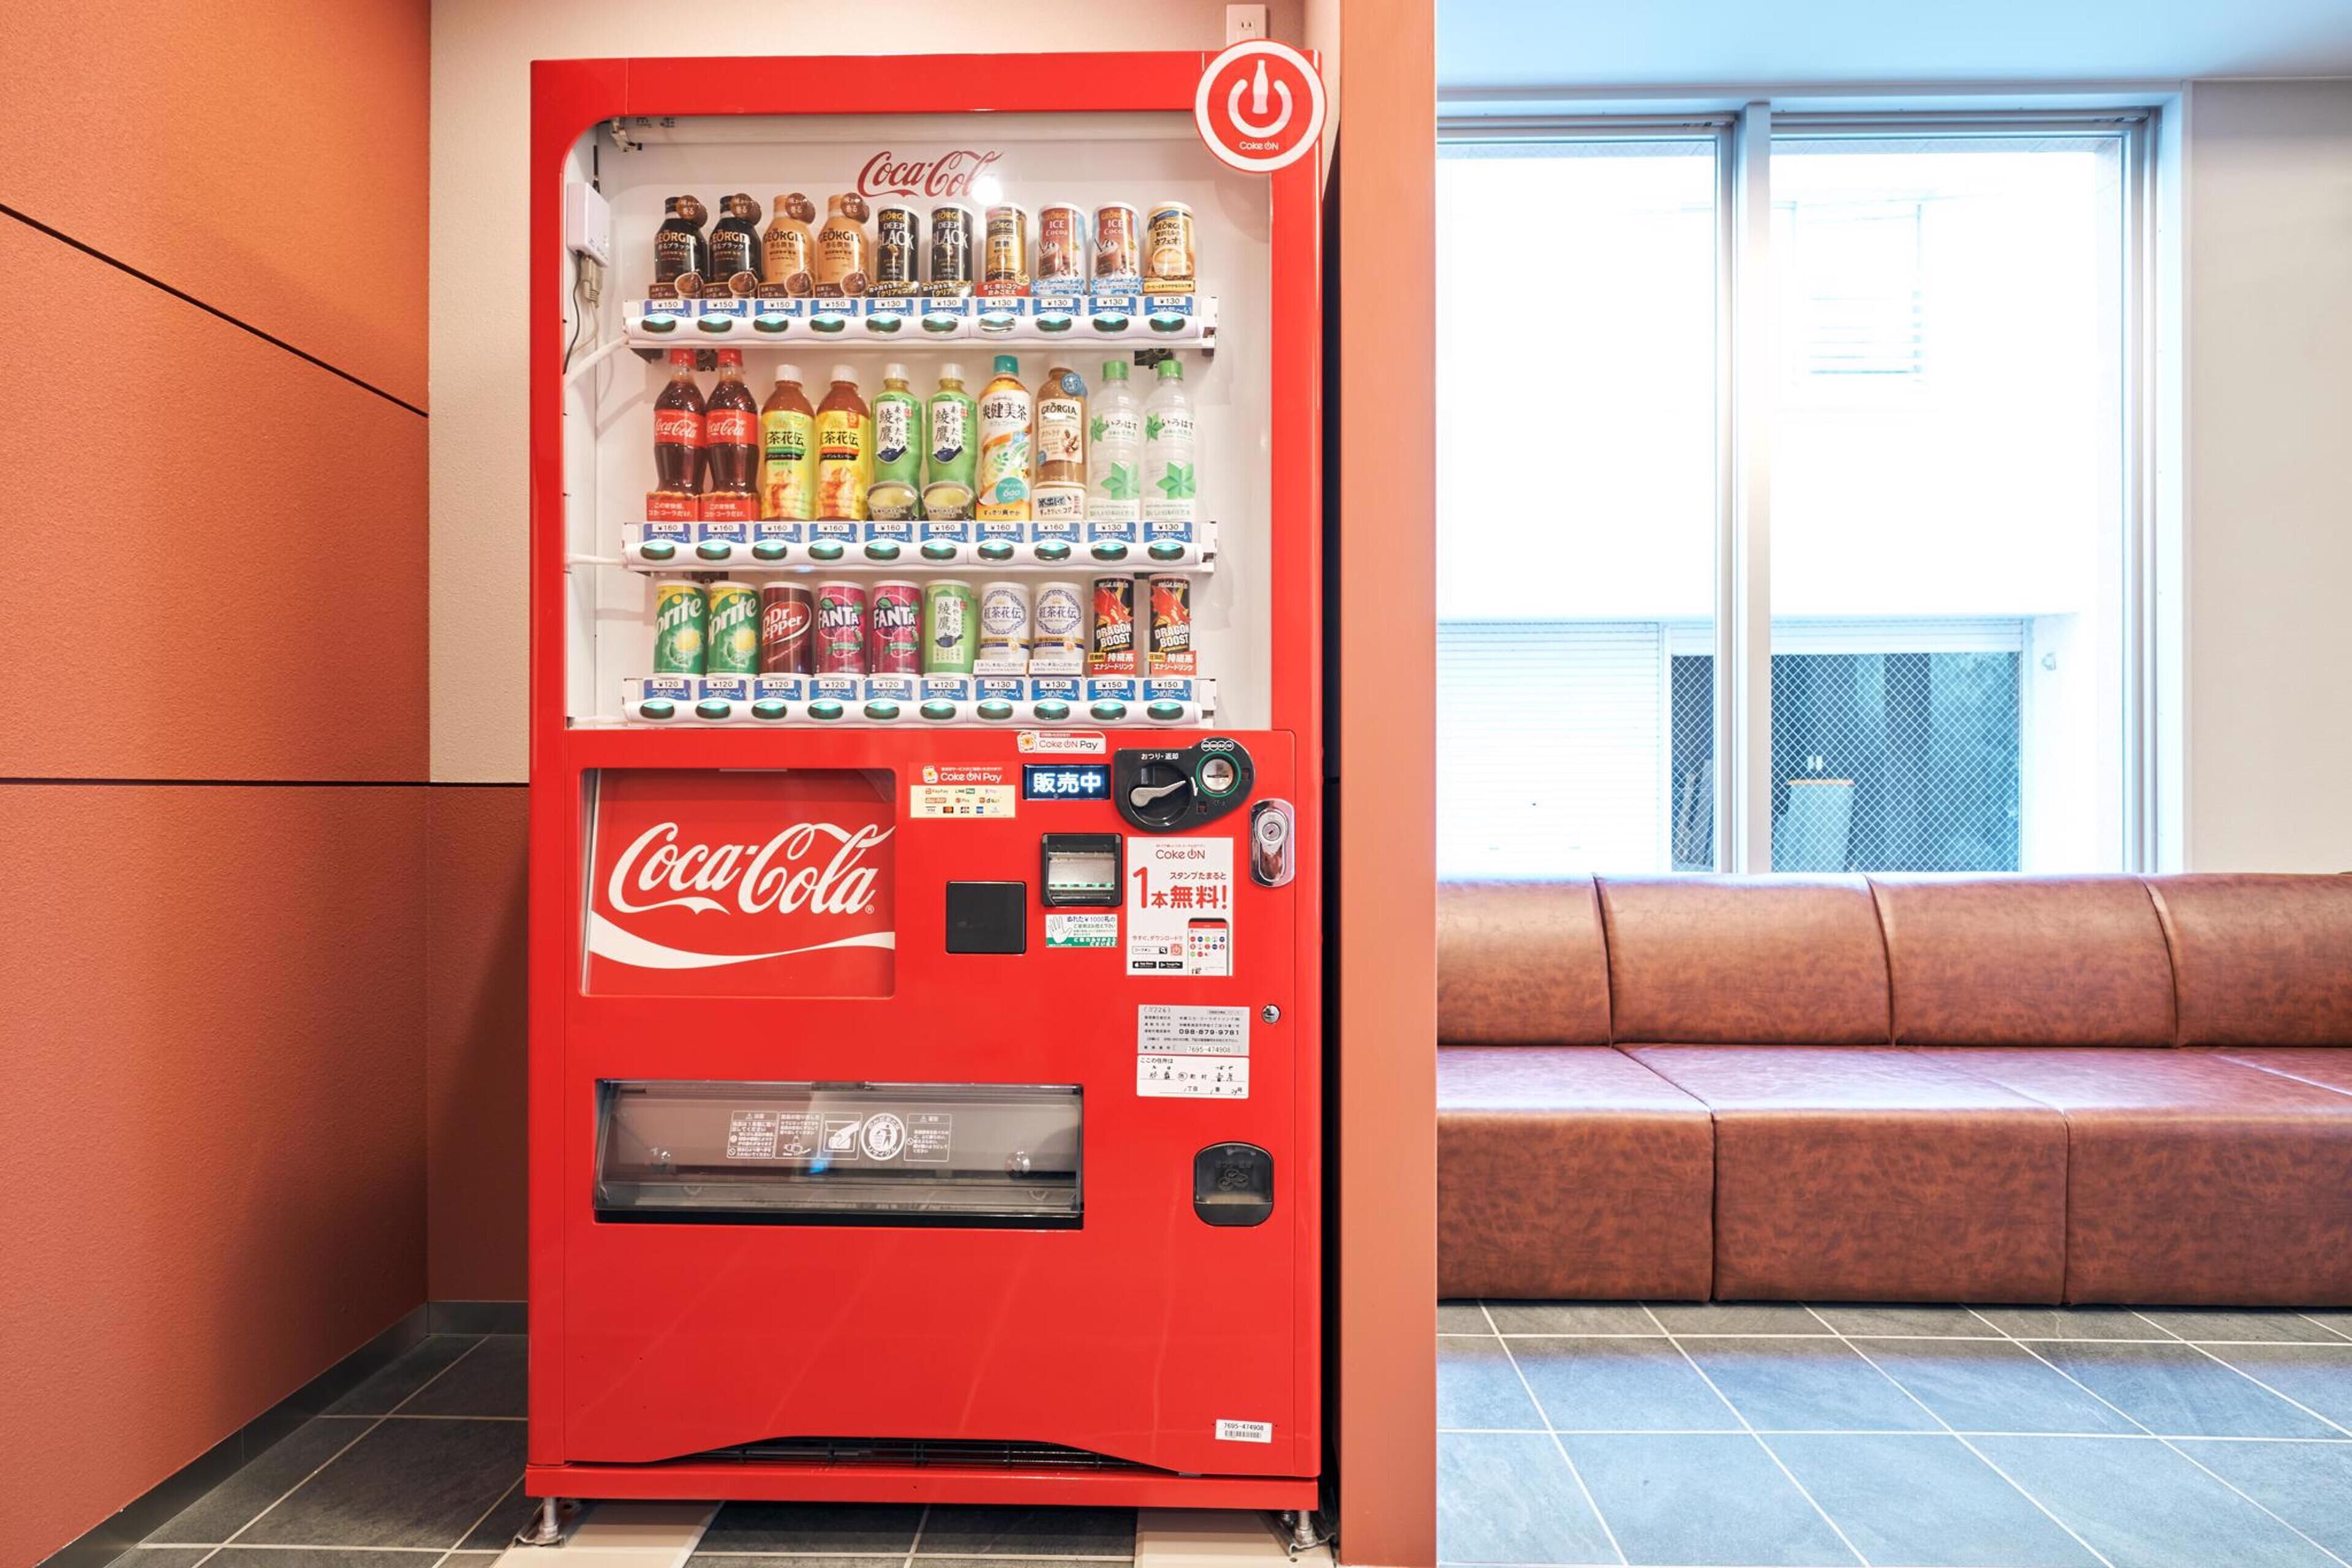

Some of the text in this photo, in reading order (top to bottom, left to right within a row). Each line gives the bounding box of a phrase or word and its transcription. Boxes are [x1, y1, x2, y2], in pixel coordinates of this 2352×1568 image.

[1239, 141, 1262, 150] Coke
[858, 151, 1003, 197] Coca-Col
[1049, 220, 1065, 229] ICE
[878, 407, 895, 443] 綾鷹
[933, 407, 950, 443] 綾鷹
[1162, 418, 1194, 430] いろはす
[766, 430, 804, 447] 茶花伝
[820, 430, 859, 447] 茶花伝
[770, 608, 790, 623] Dr
[818, 606, 859, 630] FANTA
[873, 606, 916, 629] FANTA
[1038, 605, 1077, 620] 紅茶花伝
[655, 596, 703, 645] prite
[1096, 623, 1132, 639] DRAGON
[1154, 624, 1189, 639] DRAGON
[1100, 633, 1131, 648] BOOST
[1159, 633, 1189, 648] BOOST
[1039, 740, 1063, 748] Coke
[1080, 741, 1098, 751] Pay
[940, 771, 1002, 784] Coke ON Pay
[1033, 771, 1102, 794] 販売中
[1155, 848, 1205, 860] Coke ON
[608, 822, 896, 914] Coca-Cola
[1169, 872, 1227, 880] スタンプたまると
